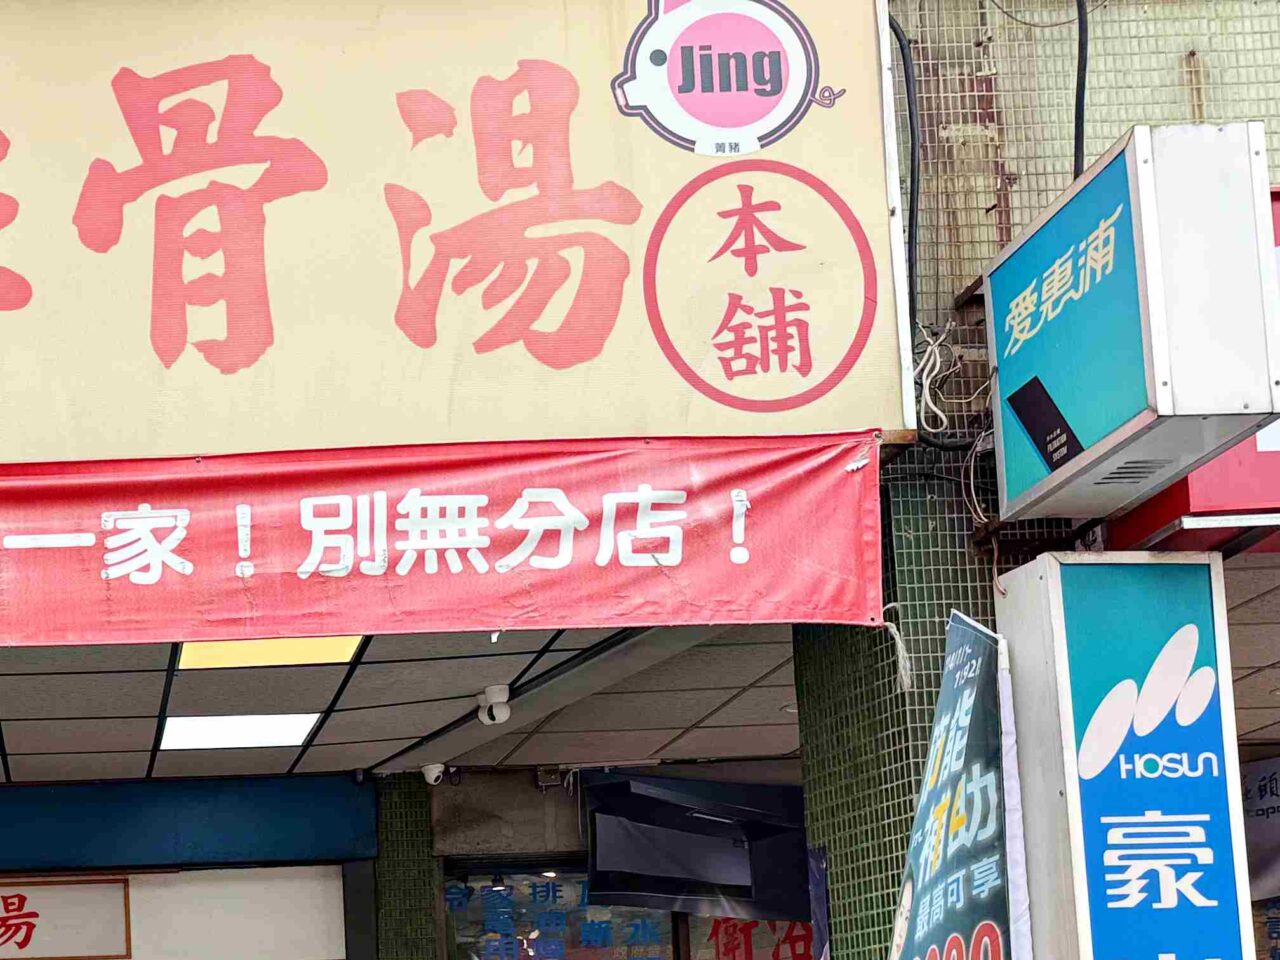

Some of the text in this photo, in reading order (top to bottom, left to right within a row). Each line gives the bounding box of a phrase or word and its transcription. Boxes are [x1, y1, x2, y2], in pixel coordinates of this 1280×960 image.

[677, 43, 783, 98] Jing
[1004, 203, 1123, 358] 愛惠浦
[1119, 752, 1218, 779] HOSUN
[914, 854, 1002, 940] 最高可享
